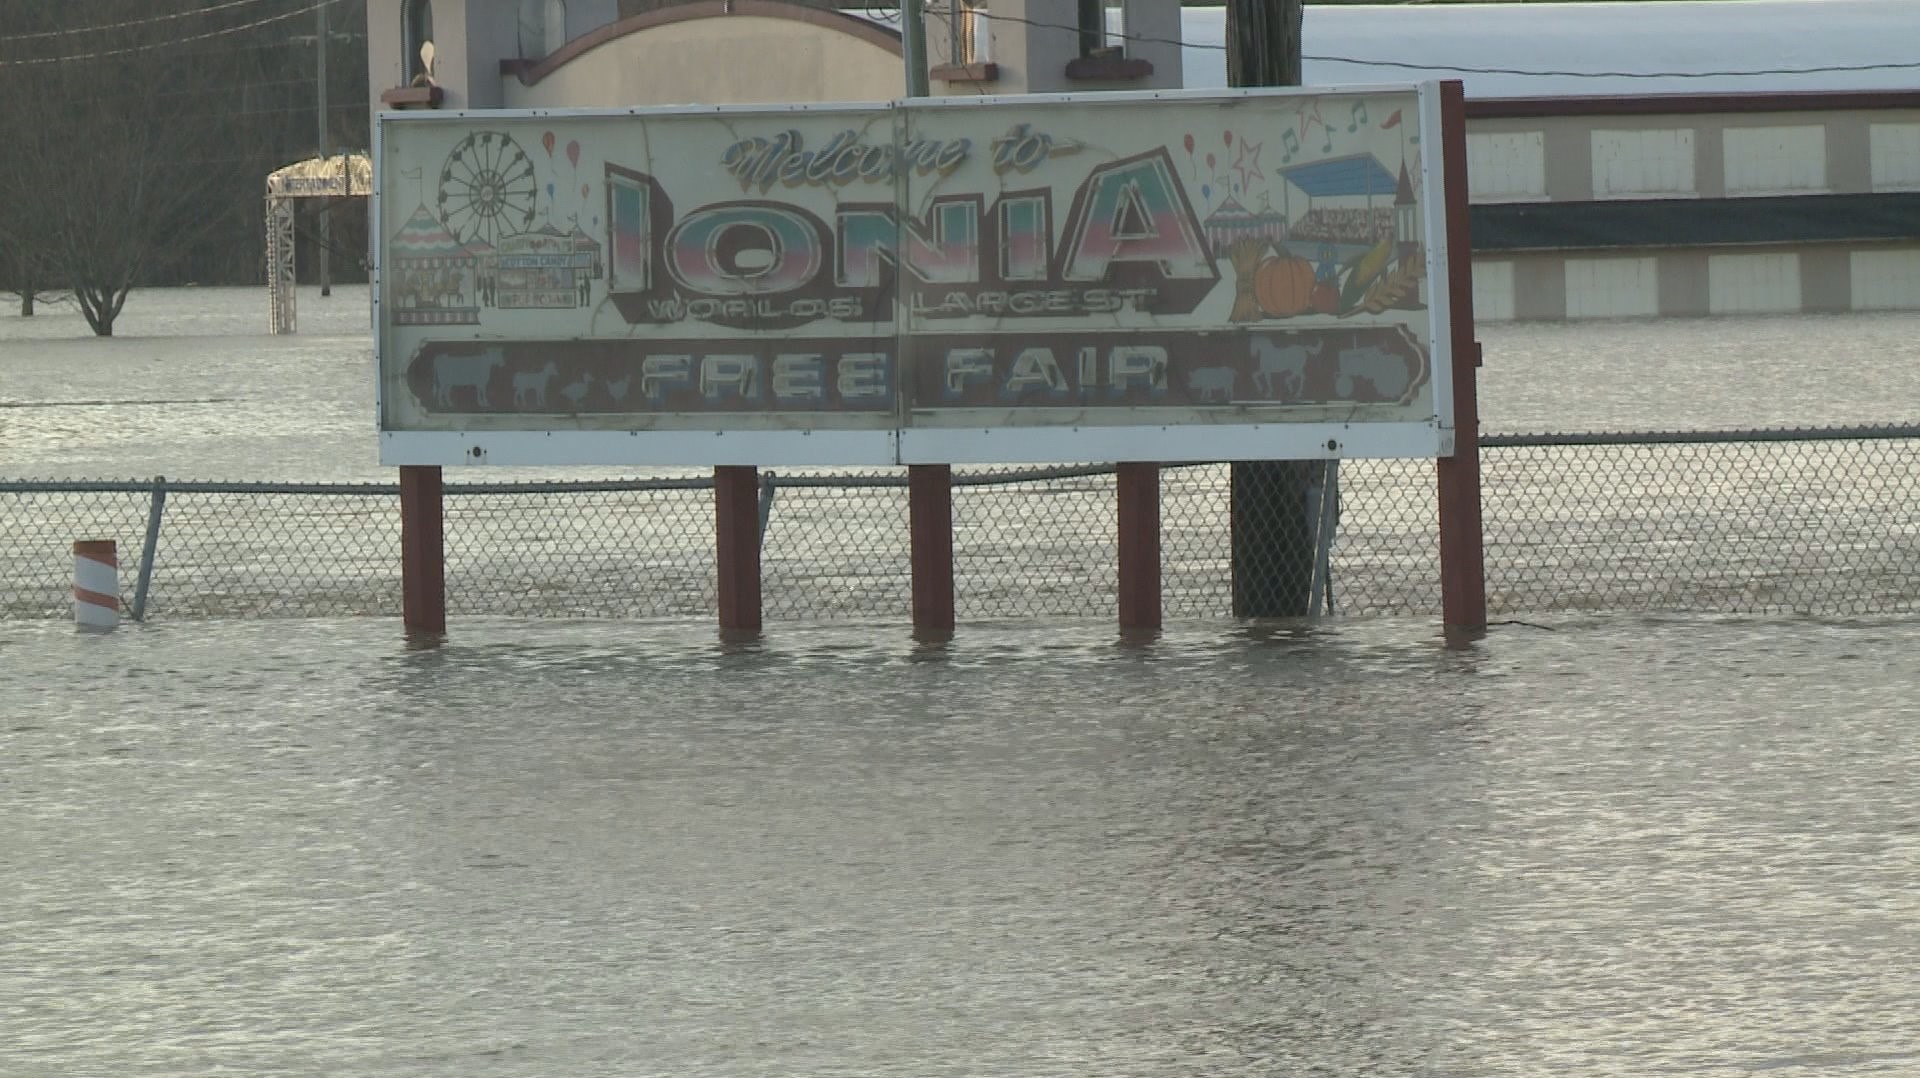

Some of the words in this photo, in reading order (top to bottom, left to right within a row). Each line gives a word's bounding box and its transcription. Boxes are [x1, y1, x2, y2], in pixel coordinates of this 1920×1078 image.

[721, 129, 971, 196] Welcome
[990, 124, 1086, 177] to
[605, 143, 1220, 310] IONIA
[910, 288, 1158, 314] LARGEST
[641, 353, 891, 400] FREE
[943, 346, 1169, 398] FAIR
